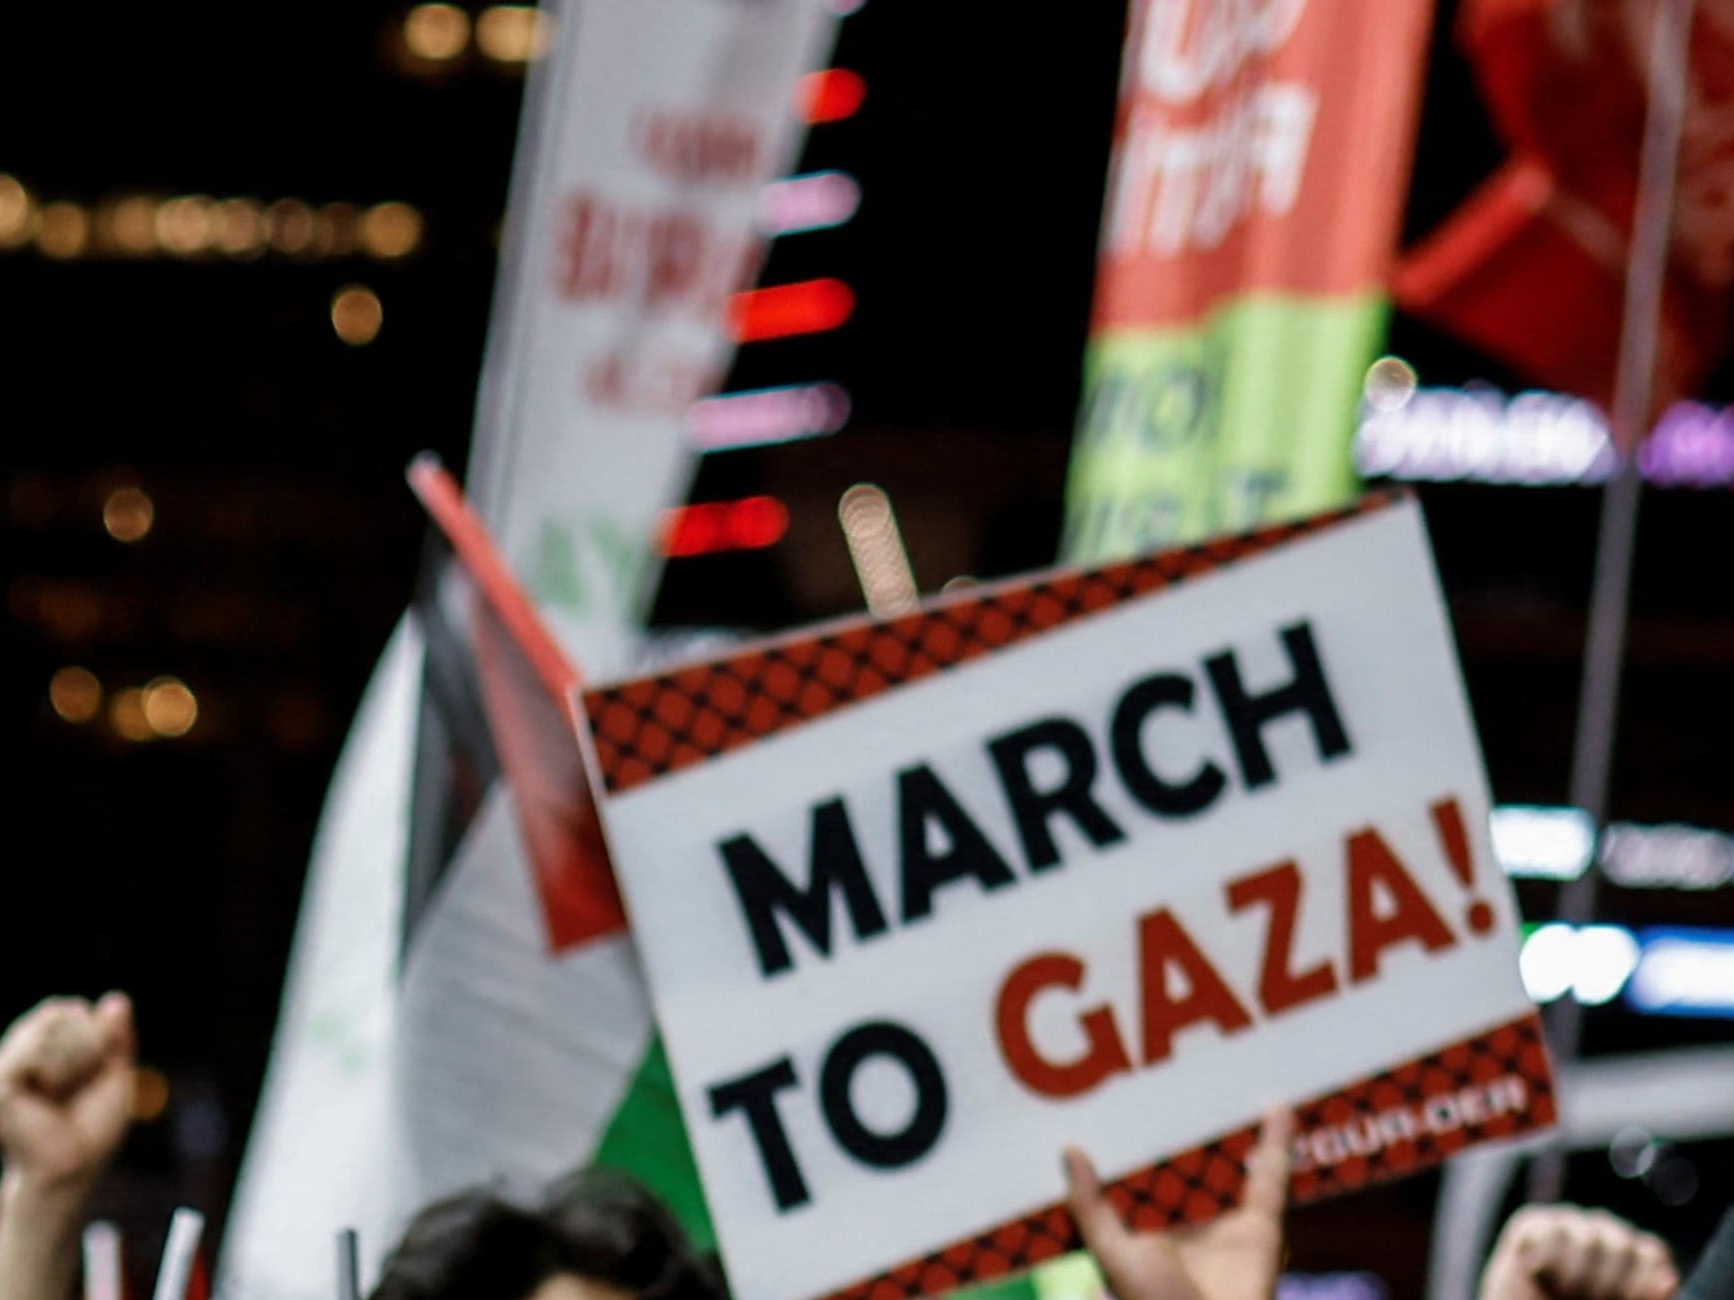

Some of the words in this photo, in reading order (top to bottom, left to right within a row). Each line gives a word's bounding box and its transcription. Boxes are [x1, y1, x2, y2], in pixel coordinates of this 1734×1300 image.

[716, 618, 1353, 980] MARCH
[706, 1019, 951, 1215] TO
[994, 798, 1496, 1100] GAZA!
